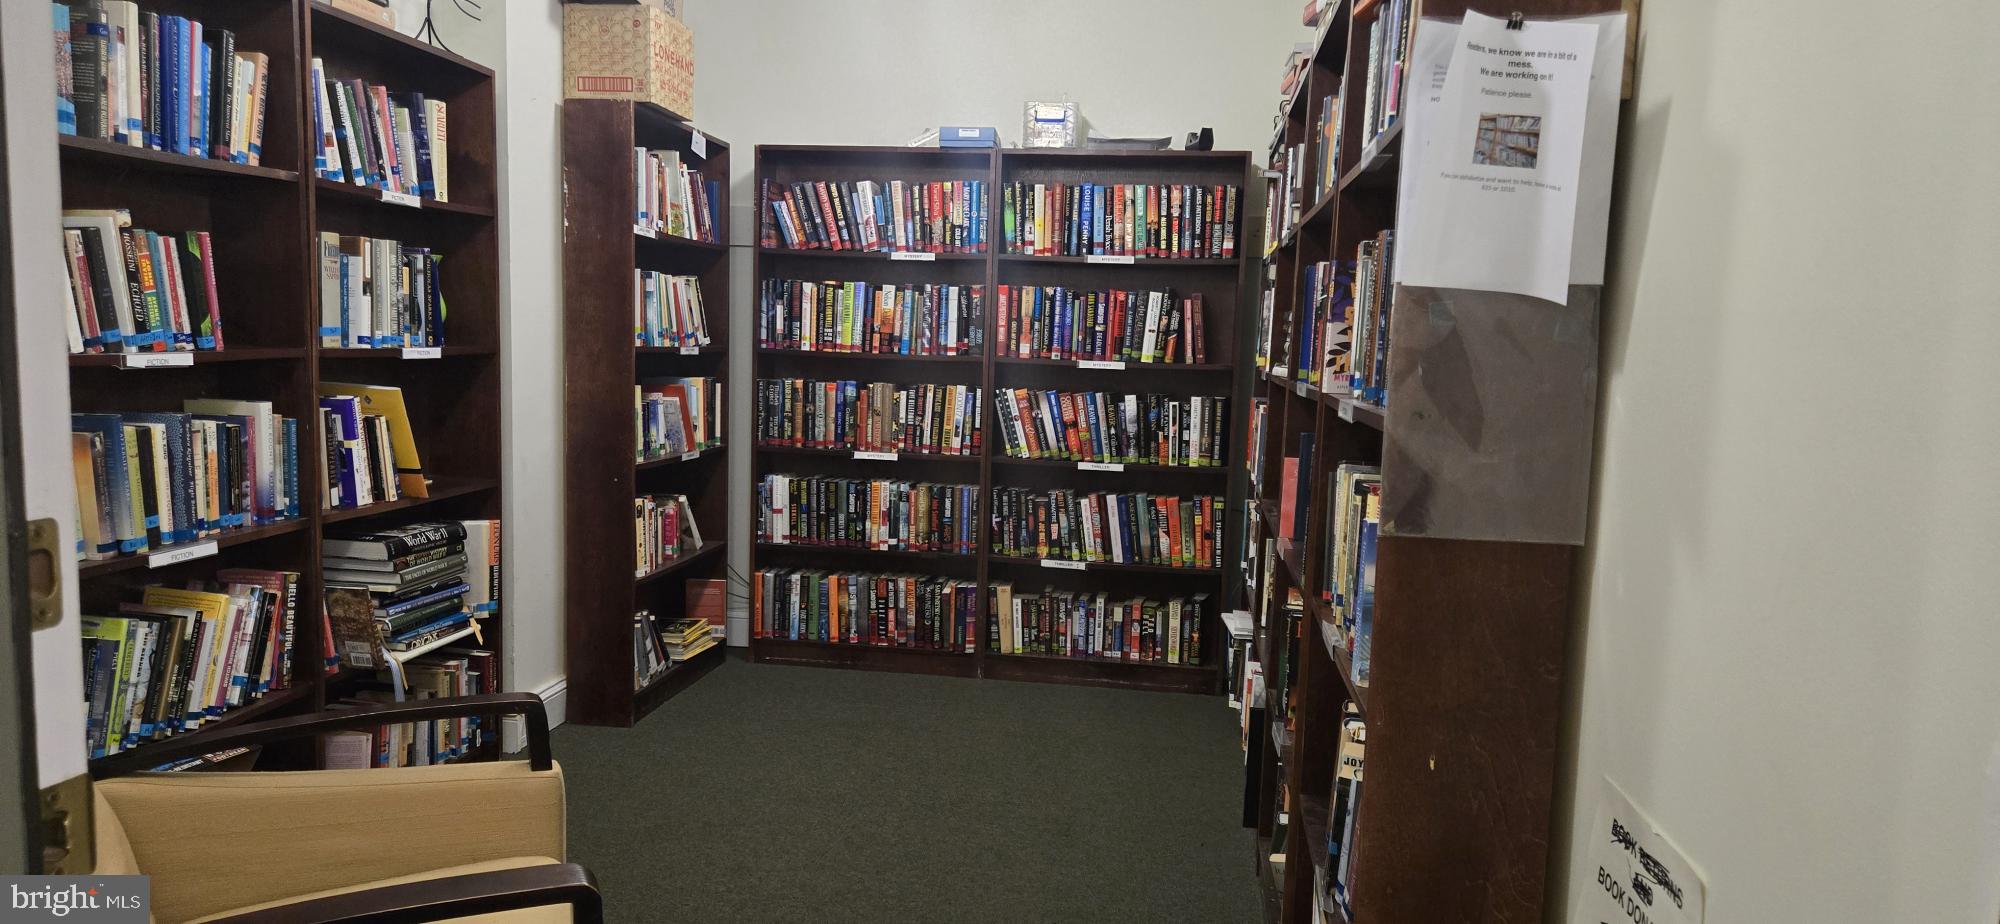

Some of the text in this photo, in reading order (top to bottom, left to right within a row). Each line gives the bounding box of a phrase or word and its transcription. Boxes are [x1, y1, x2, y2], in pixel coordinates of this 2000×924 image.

[1488, 48, 1498, 56] we
[1498, 47, 1523, 57] know
[1524, 50, 1536, 58] we
[1507, 60, 1534, 69] mess.
[1480, 67, 1490, 77] We
[1490, 70, 1504, 78] are
[1504, 70, 1539, 82] working
[1539, 73, 1547, 81] on
[1481, 88, 1506, 97] Patience
[130, 282, 144, 321] ECHOED
[1097, 303, 1105, 323] SANDFORD
[403, 532, 427, 547] World
[426, 529, 442, 541] War
[171, 551, 194, 562] FICTION
[284, 583, 296, 651] HELLO BEAUTIFUL
[1598, 865, 1626, 908] BOOK
